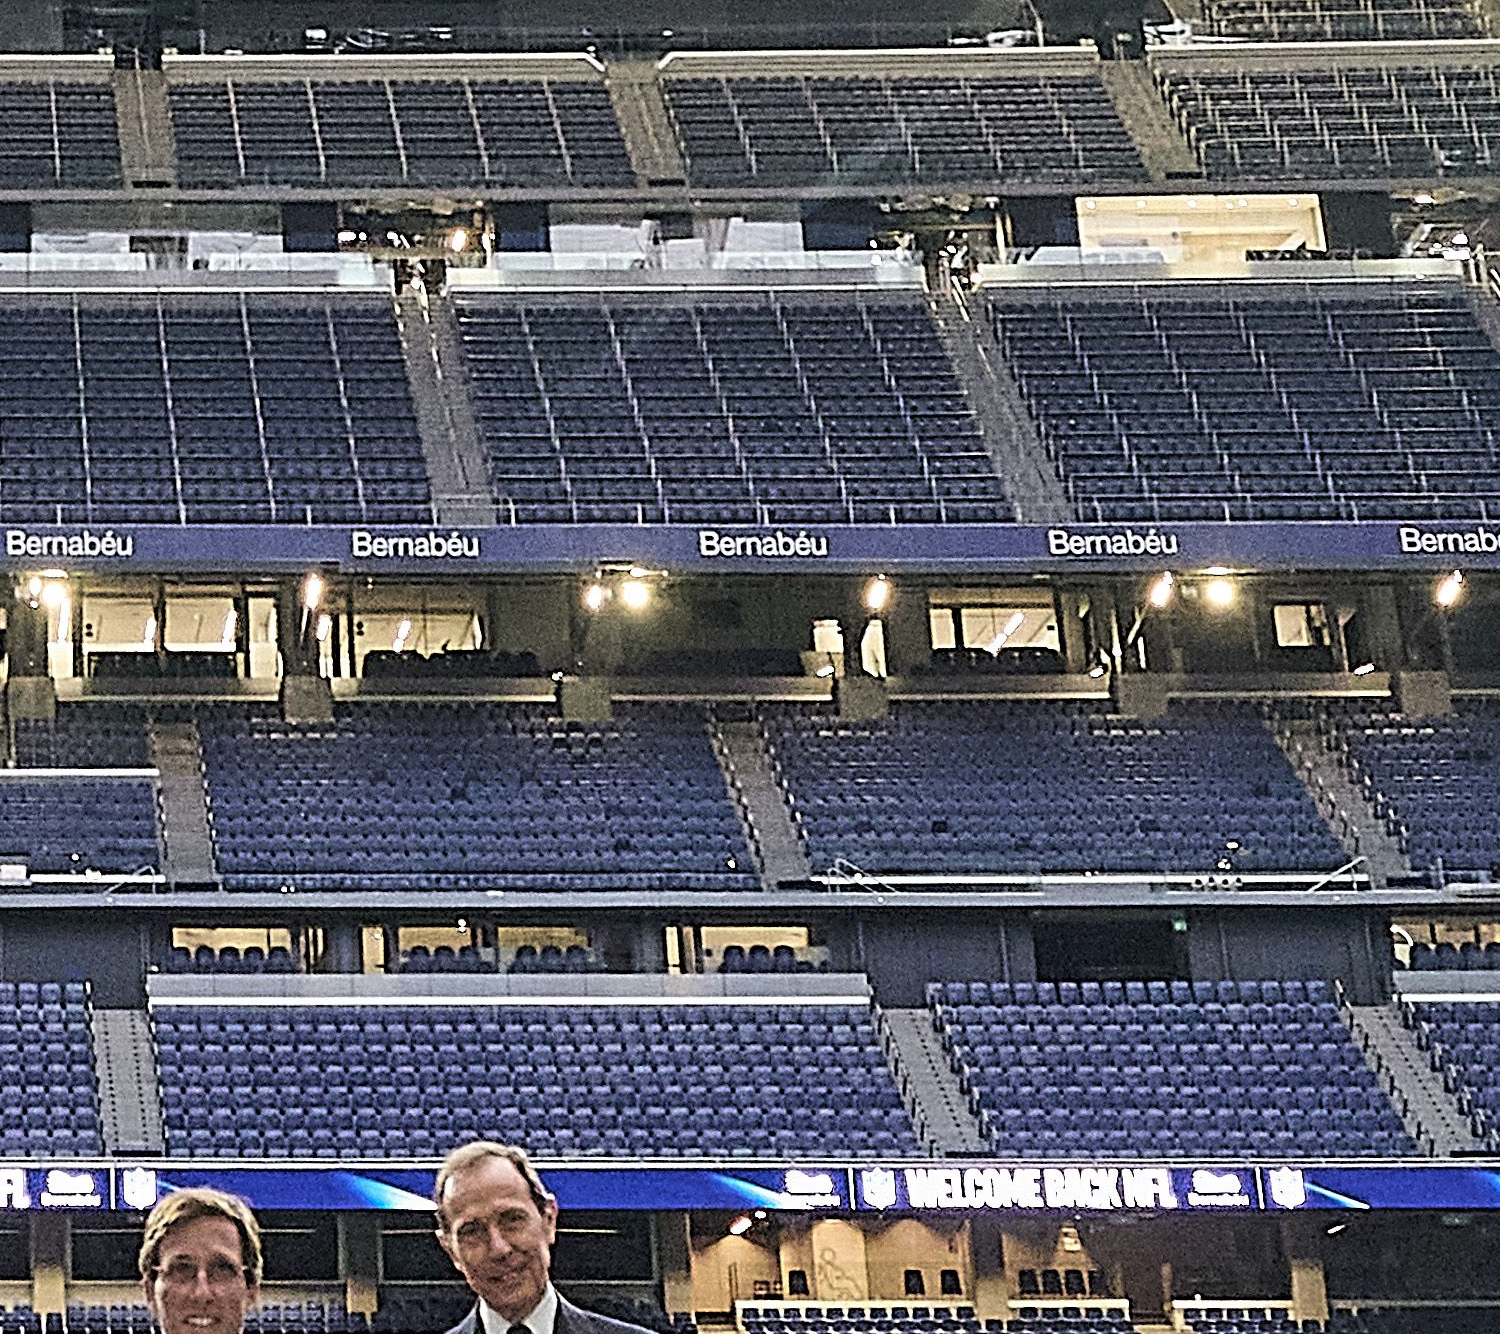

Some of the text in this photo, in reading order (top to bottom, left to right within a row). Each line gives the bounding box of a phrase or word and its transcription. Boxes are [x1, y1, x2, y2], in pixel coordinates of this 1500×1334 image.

[5, 529, 133, 556] Bernabéu
[351, 530, 480, 557] Bernabéu
[698, 530, 828, 557] Bernabéu
[1047, 528, 1179, 555] Bernabéu
